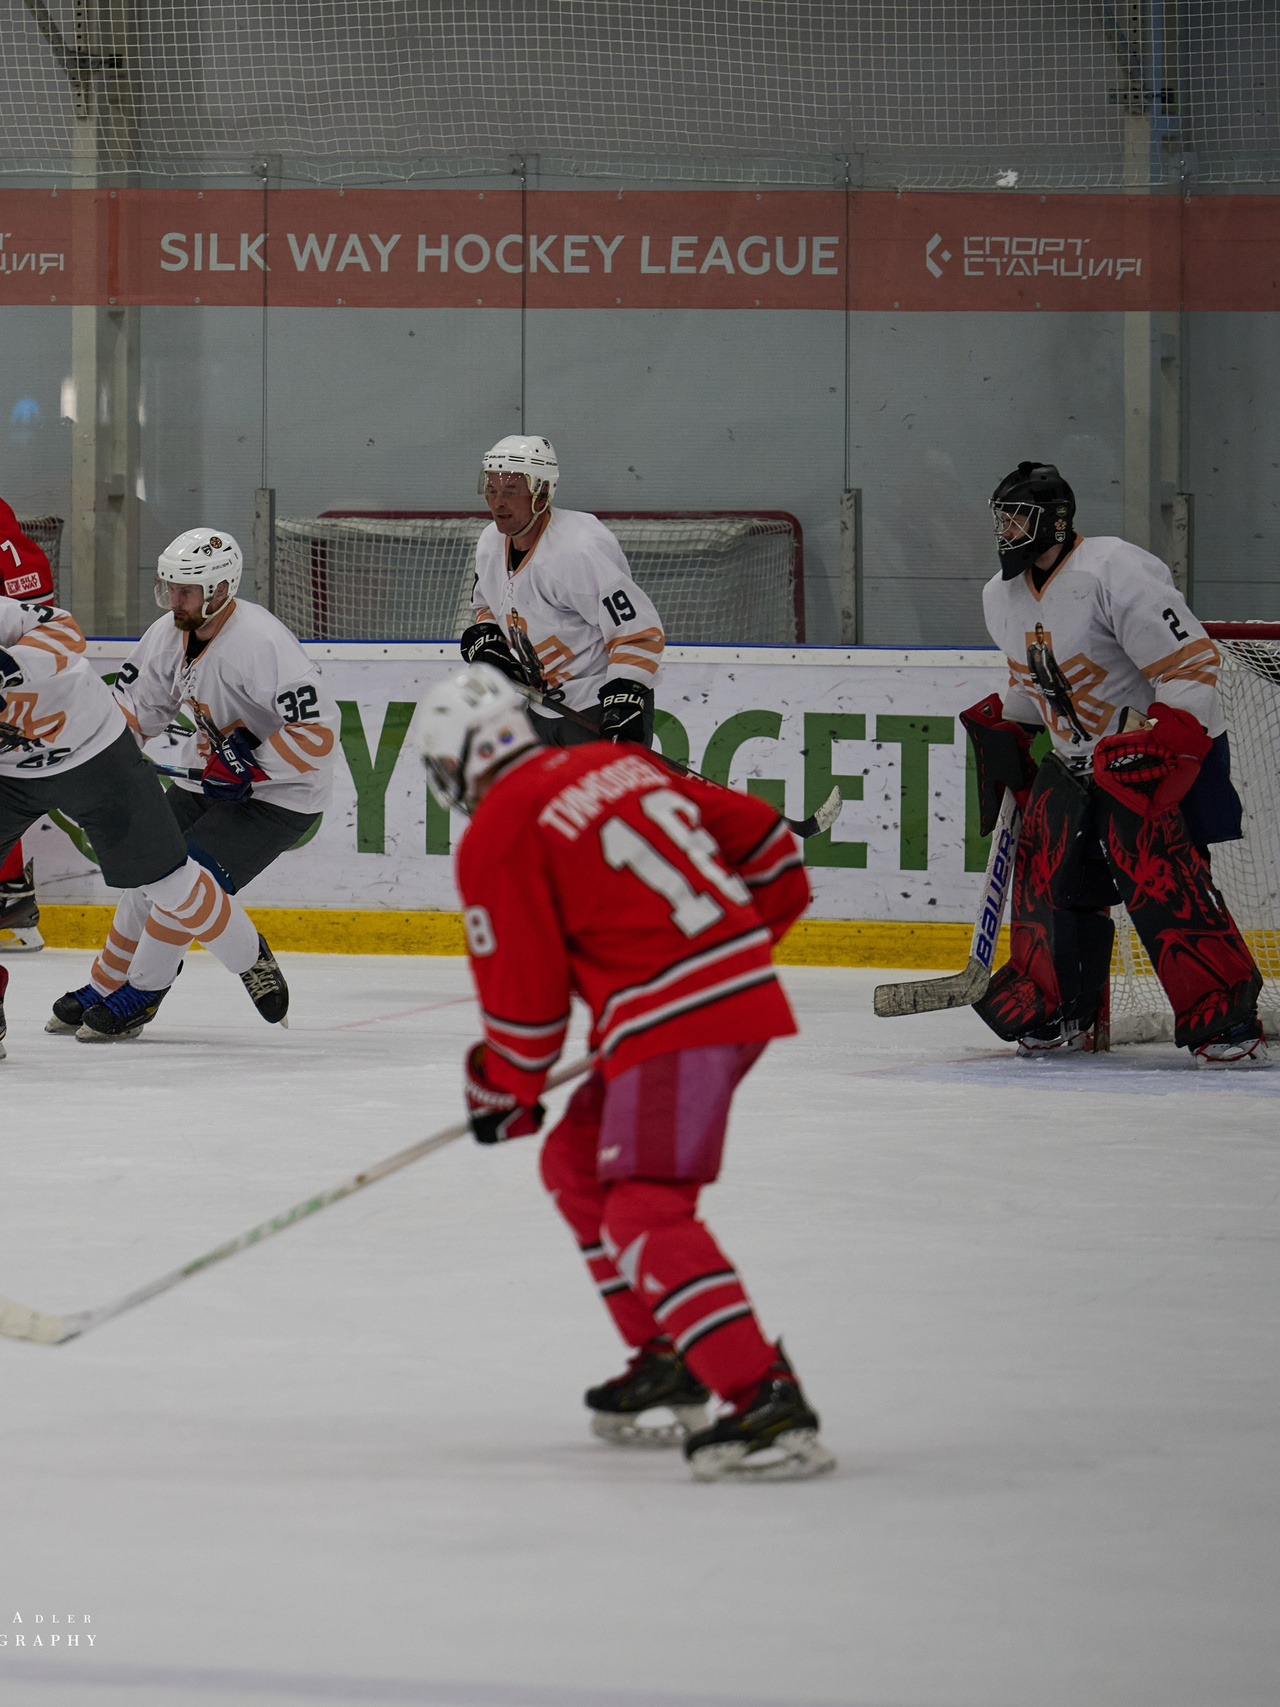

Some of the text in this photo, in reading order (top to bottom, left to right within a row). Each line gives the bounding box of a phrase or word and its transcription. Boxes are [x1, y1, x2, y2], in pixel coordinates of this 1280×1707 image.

[160, 232, 839, 275] SILK WAY HOCKEY LEAGUE
[963, 236, 1091, 256] СПОРТ
[963, 257, 1141, 280] СТАНЦИЯ
[0, 538, 22, 568] 7
[20, 574, 37, 584] SILK
[21, 580, 39, 590] WAY
[602, 589, 637, 627] 19
[1162, 607, 1189, 642] 2
[277, 685, 320, 722] 32
